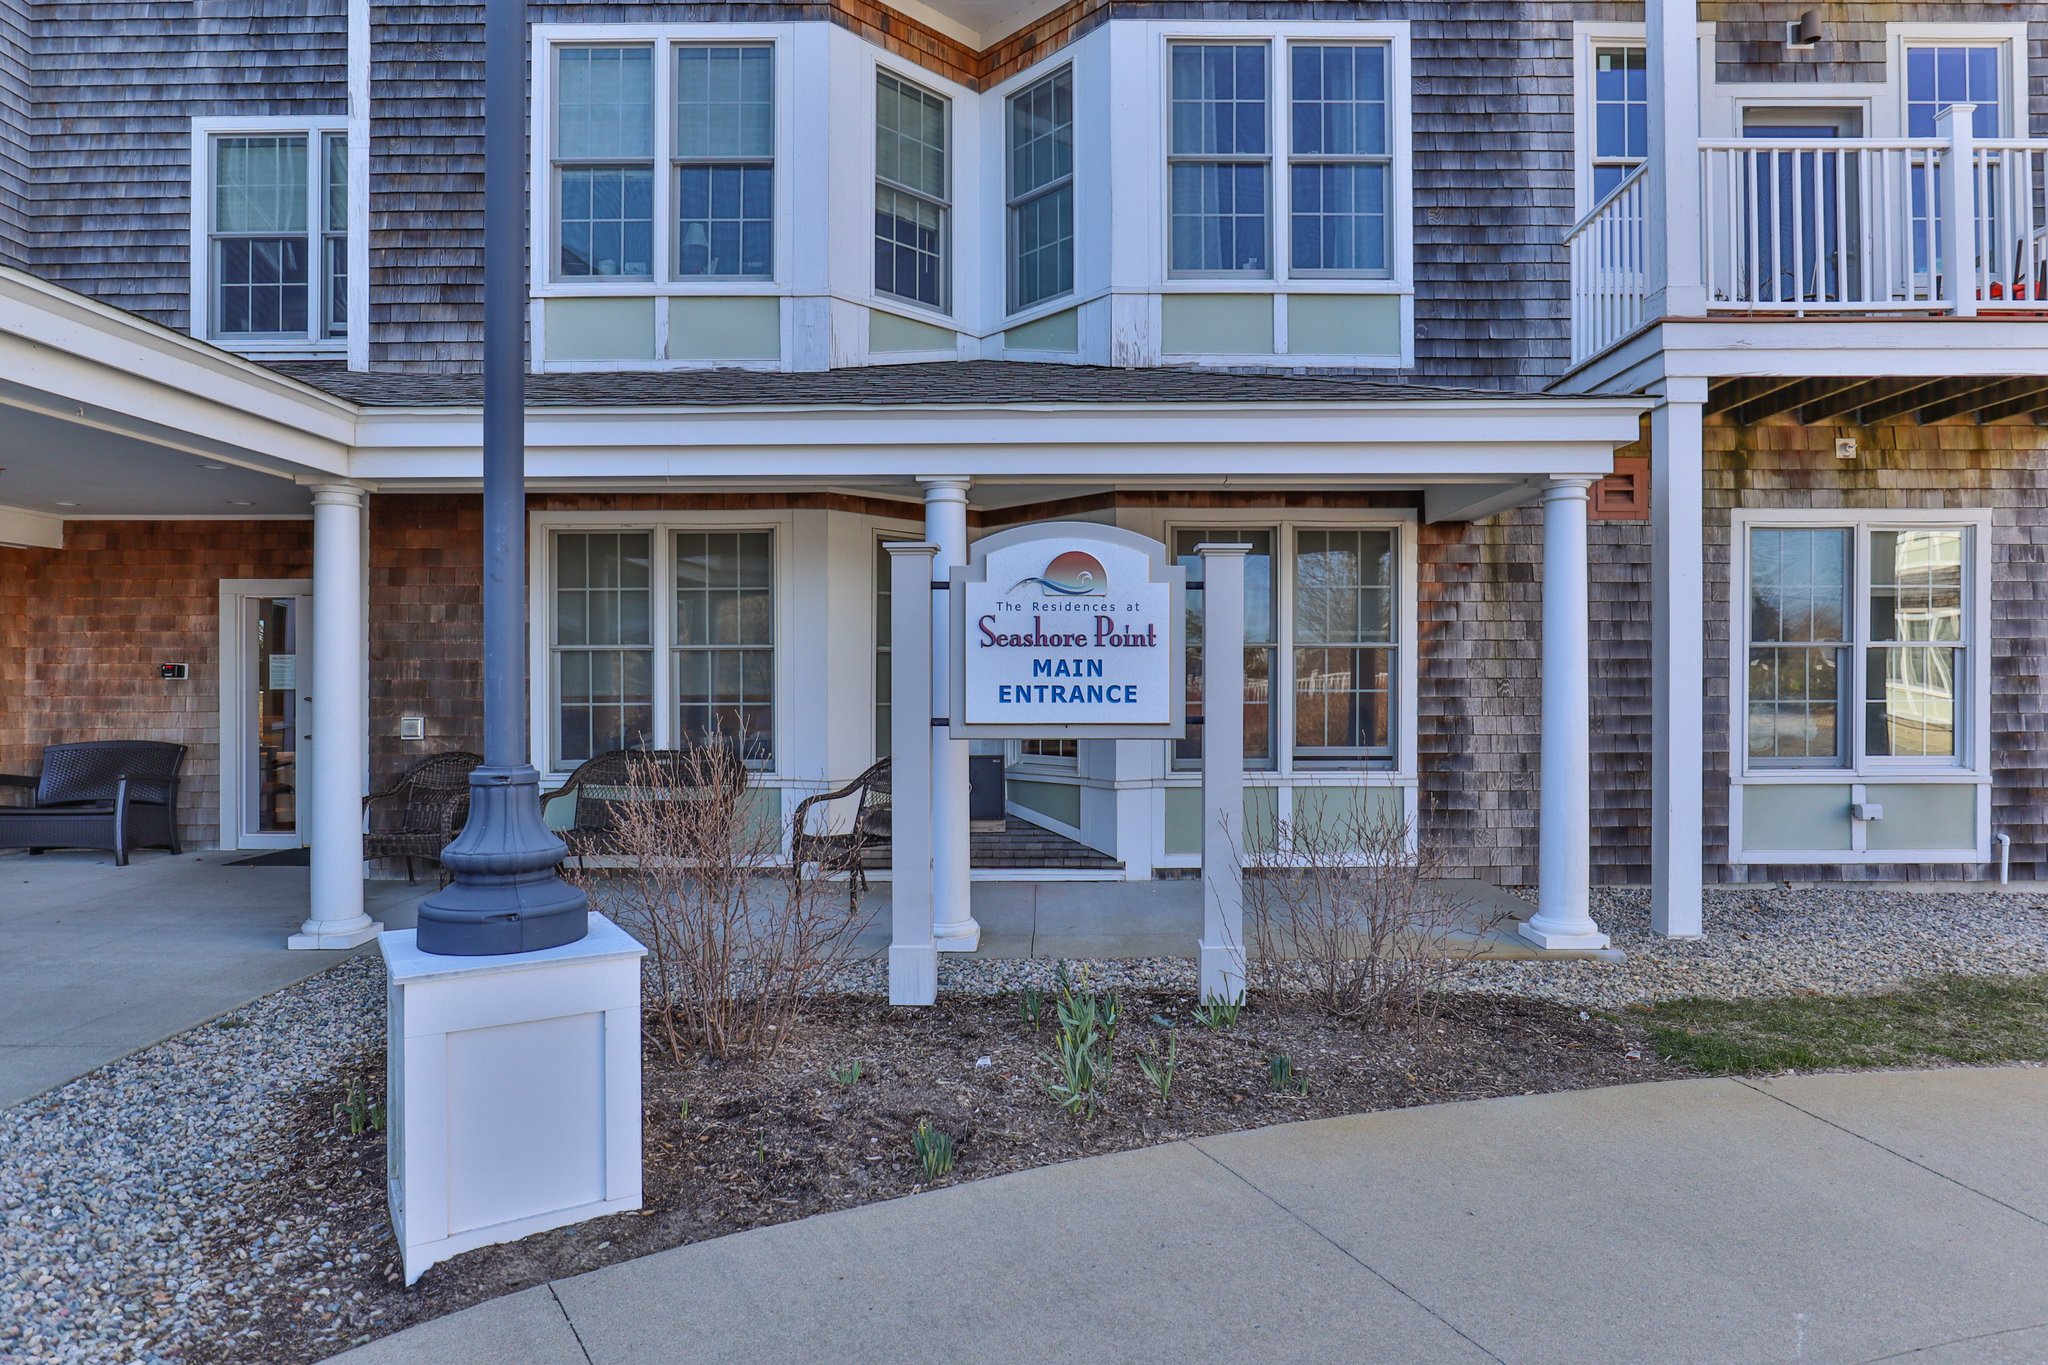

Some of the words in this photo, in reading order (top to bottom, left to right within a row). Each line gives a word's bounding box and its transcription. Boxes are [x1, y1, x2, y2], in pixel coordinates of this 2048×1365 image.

[996, 601, 1022, 612] The
[1033, 601, 1116, 612] Residences
[1127, 602, 1140, 612] at
[978, 614, 1087, 648] Seashore
[1093, 615, 1157, 648] Point
[1032, 658, 1103, 678] MAIN
[999, 685, 1138, 704] ENTRANCE
